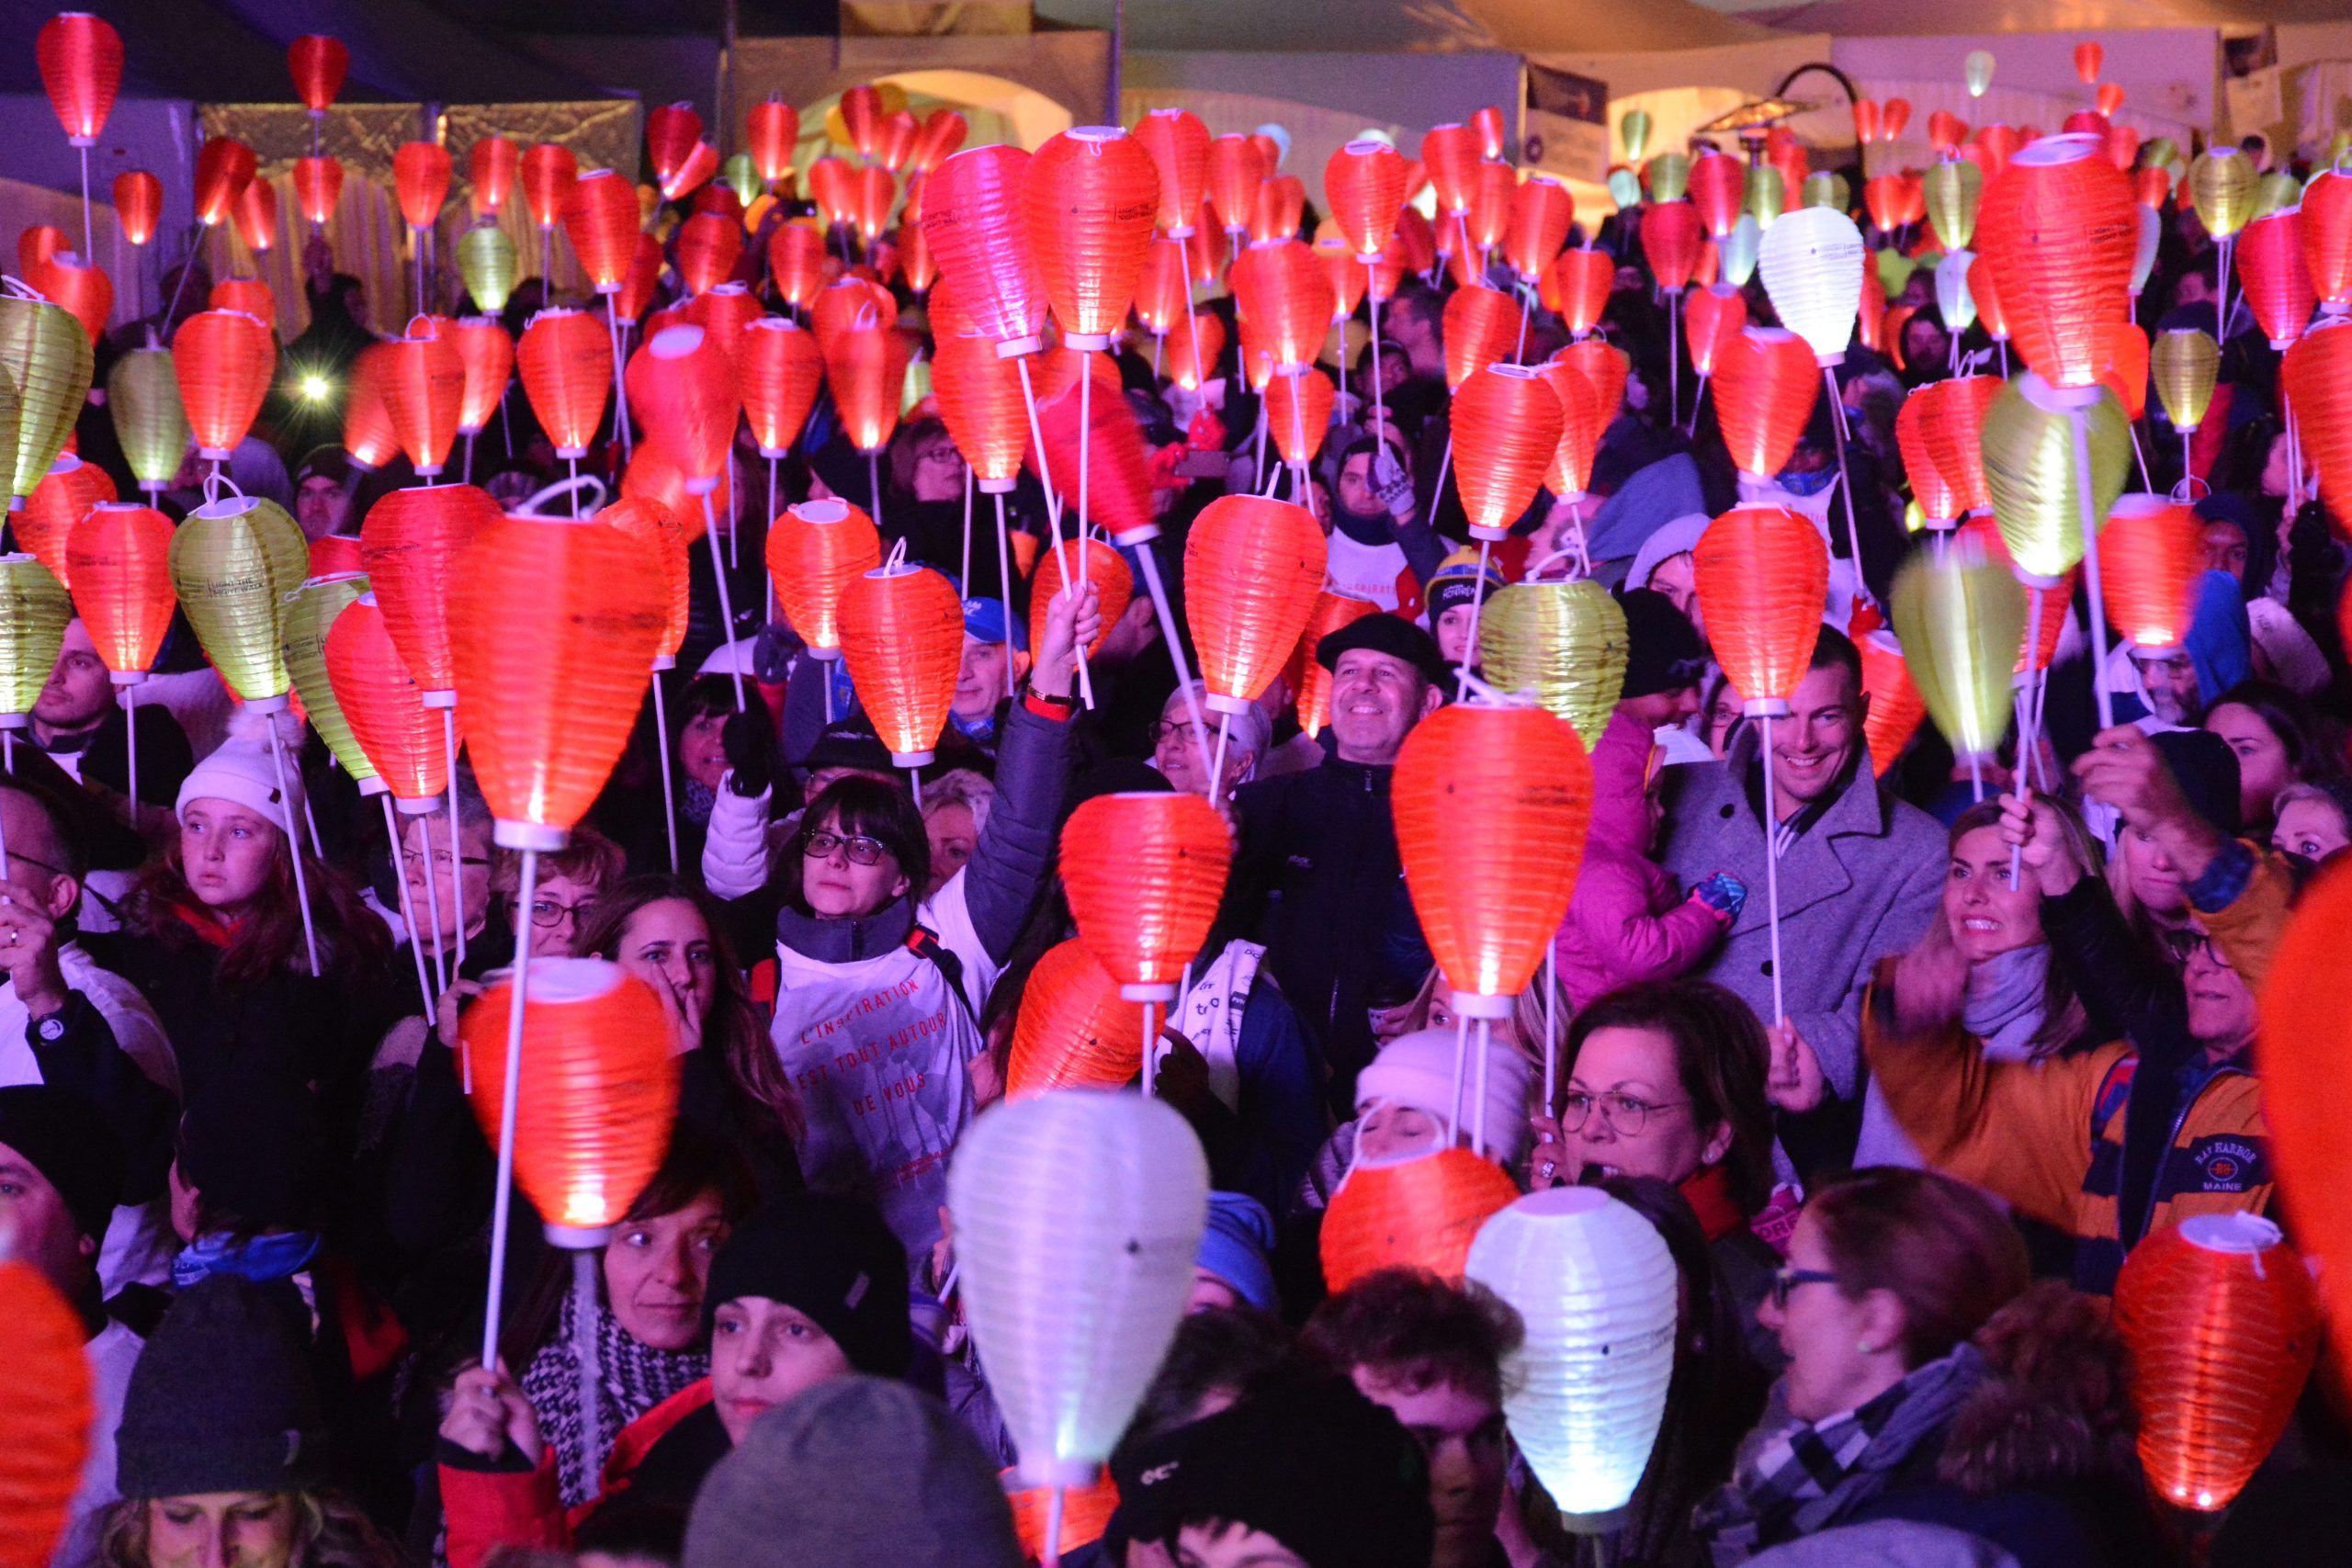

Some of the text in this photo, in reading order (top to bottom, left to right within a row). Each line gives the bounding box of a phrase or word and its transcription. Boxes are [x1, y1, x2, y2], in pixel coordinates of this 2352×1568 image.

[797, 1012, 947, 1090] EST TOUT AUTOUR
[853, 1072, 927, 1117] DE VOUS
[2214, 1142, 2257, 1165] HARBOR
[2203, 1181, 2243, 1191] MAINE
